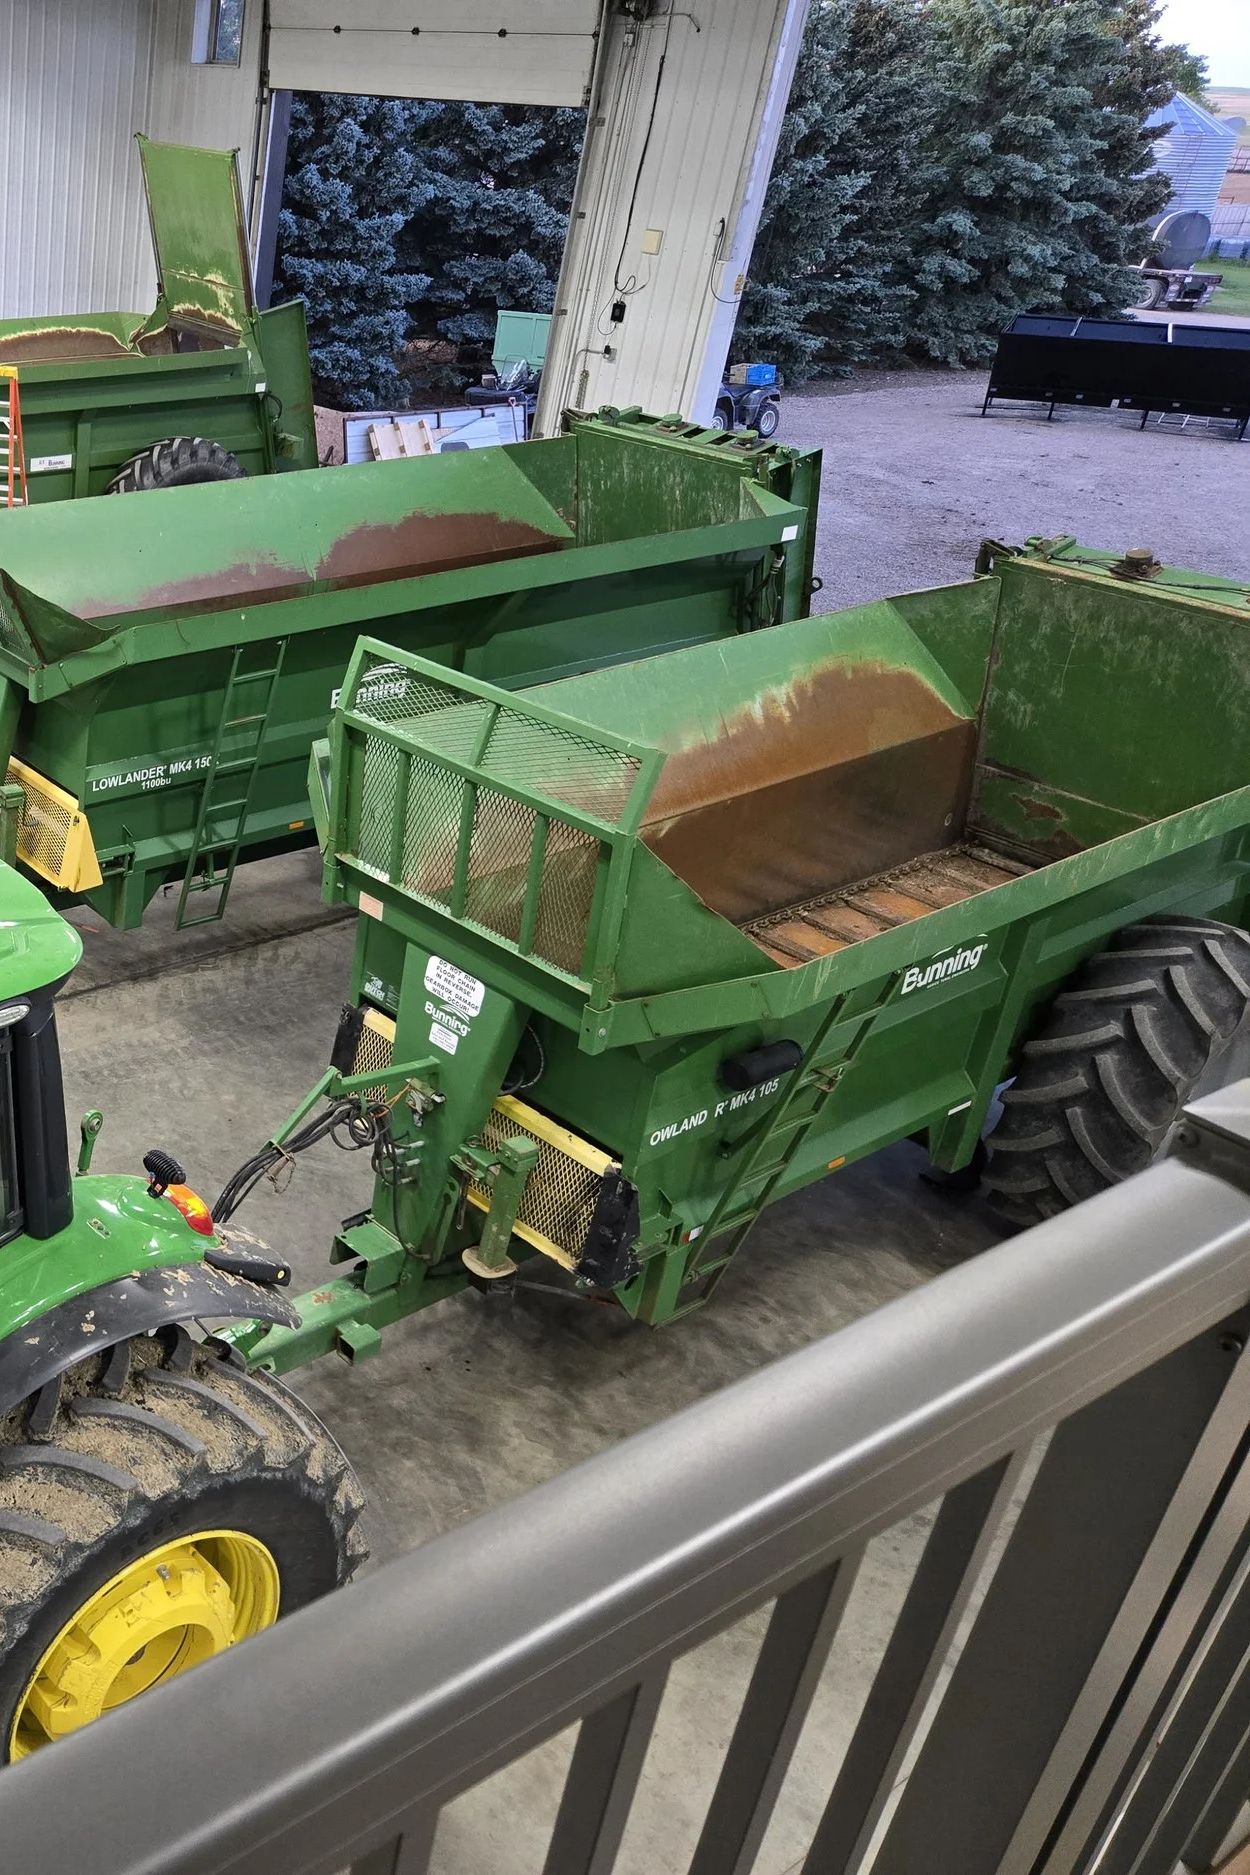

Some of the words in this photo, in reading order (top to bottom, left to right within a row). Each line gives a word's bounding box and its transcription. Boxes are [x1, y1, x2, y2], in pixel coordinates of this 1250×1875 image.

[92, 765, 165, 791] LOWLANDER
[169, 759, 193, 774] MK4
[141, 777, 172, 790] 1100bu
[436, 966, 455, 979] FLOOR
[458, 978, 476, 992] CHAIN
[439, 960, 448, 968] DO
[450, 965, 462, 976] NOT
[464, 974, 477, 985] RUN
[900, 944, 984, 995] Bunning
[425, 976, 453, 996] GEARBOX
[454, 993, 479, 1012] DAMAGE
[432, 987, 445, 999] WILL
[447, 996, 470, 1013] OCCUR!
[424, 1000, 469, 1036] Bunning
[730, 1088, 757, 1110] MK4
[759, 1078, 780, 1097] 105
